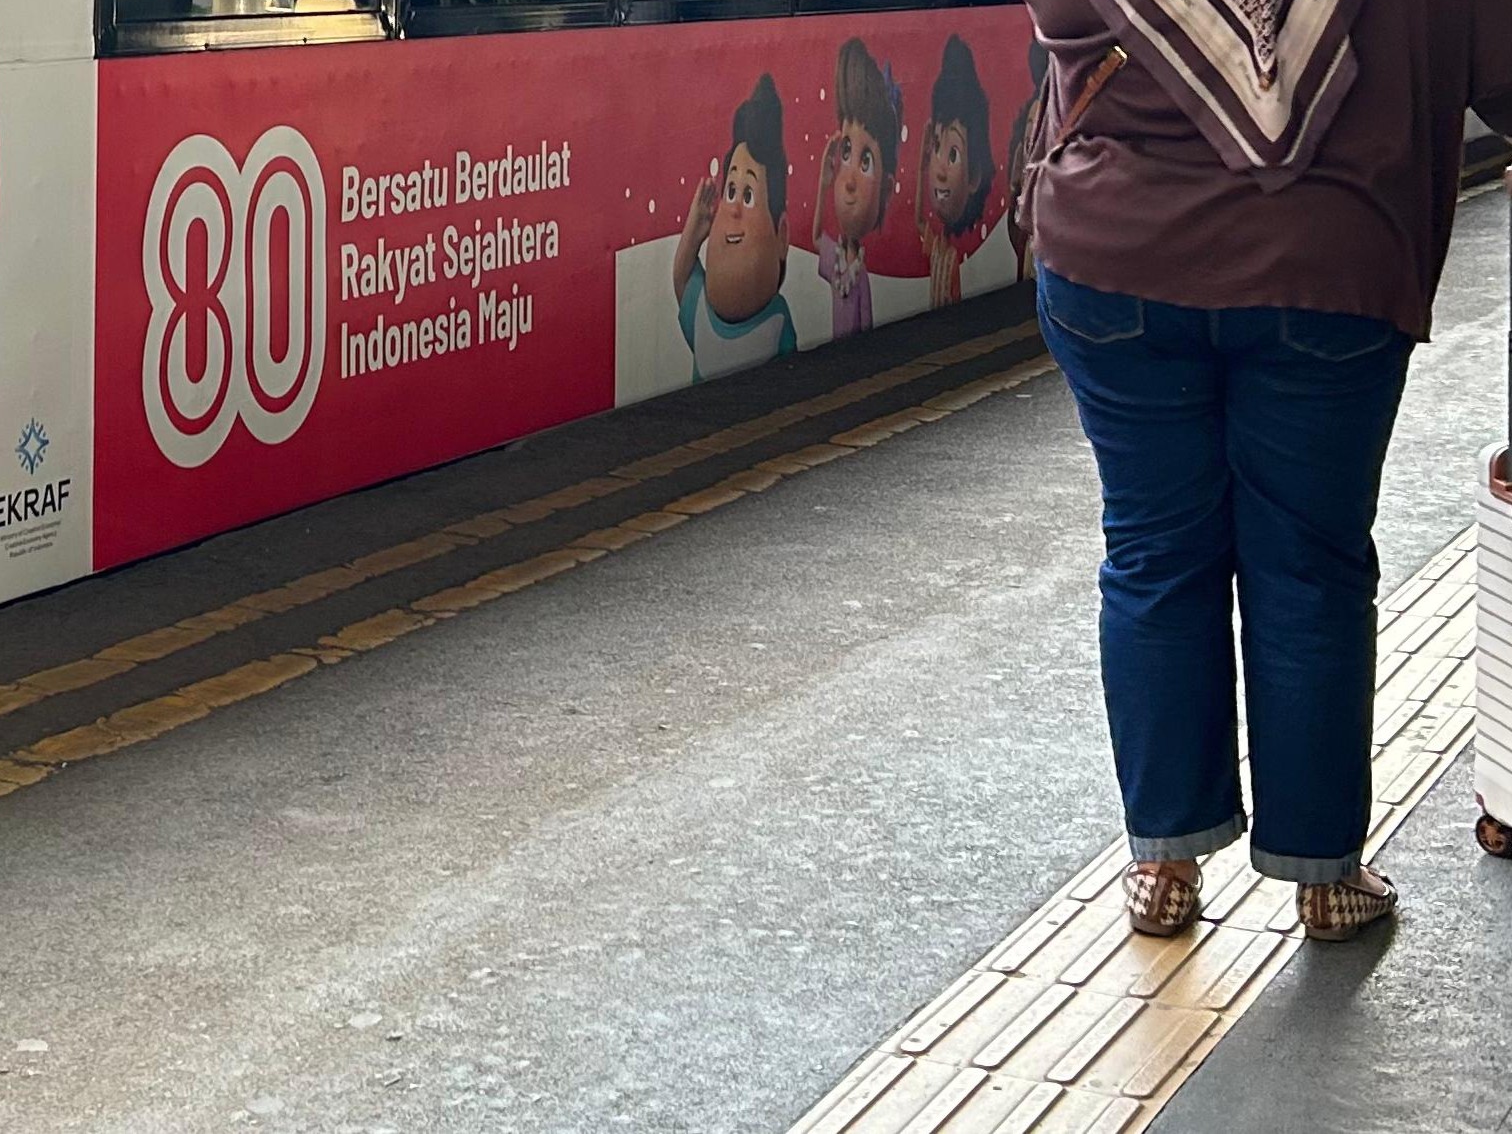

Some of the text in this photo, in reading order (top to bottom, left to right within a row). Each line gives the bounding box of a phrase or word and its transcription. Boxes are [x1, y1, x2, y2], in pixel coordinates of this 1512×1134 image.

[340, 140, 572, 223] Bersatu Berdaulat
[142, 124, 327, 468] 80
[340, 216, 559, 304] Rakyat Sejahtera
[340, 283, 533, 379] Indonesia Maju
